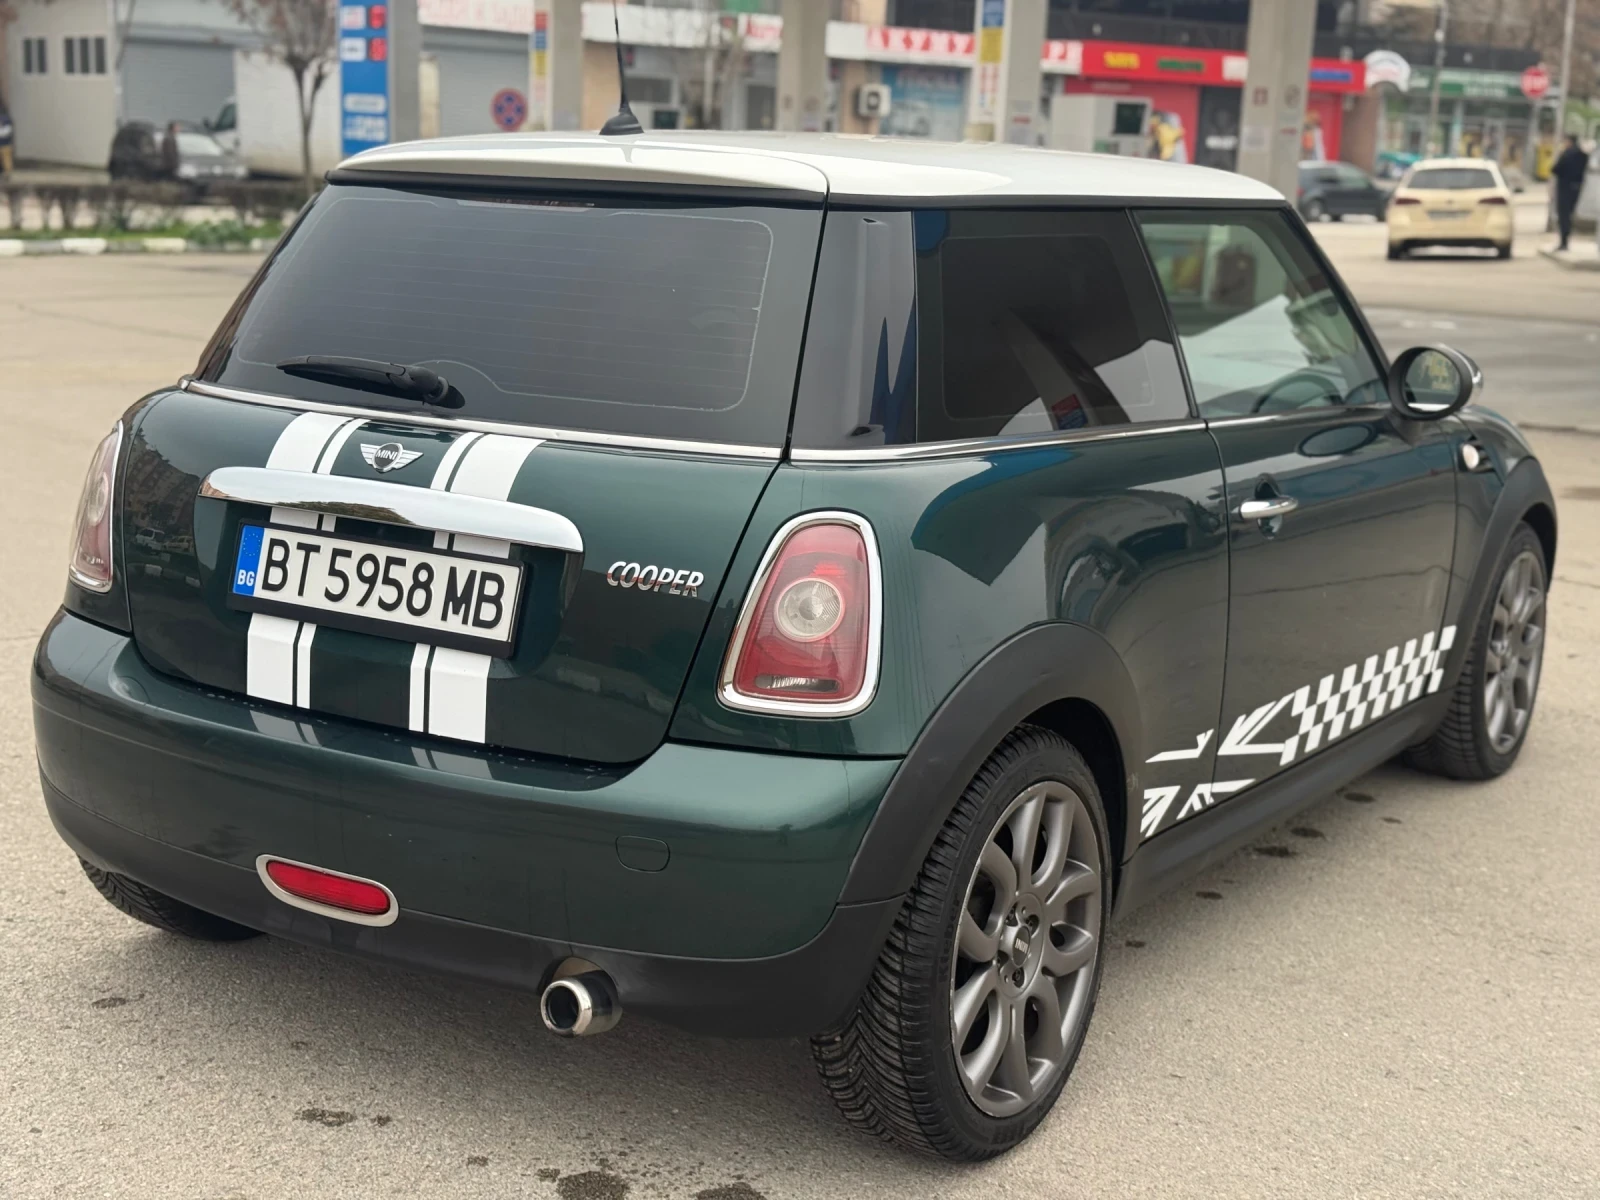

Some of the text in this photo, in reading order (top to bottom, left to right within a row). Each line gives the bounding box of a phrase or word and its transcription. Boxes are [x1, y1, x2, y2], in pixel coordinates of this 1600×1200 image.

[375, 449, 398, 460] MINI
[236, 569, 256, 587] BG
[261, 537, 505, 629] BT 5958 MB
[606, 560, 705, 597] COOPER
